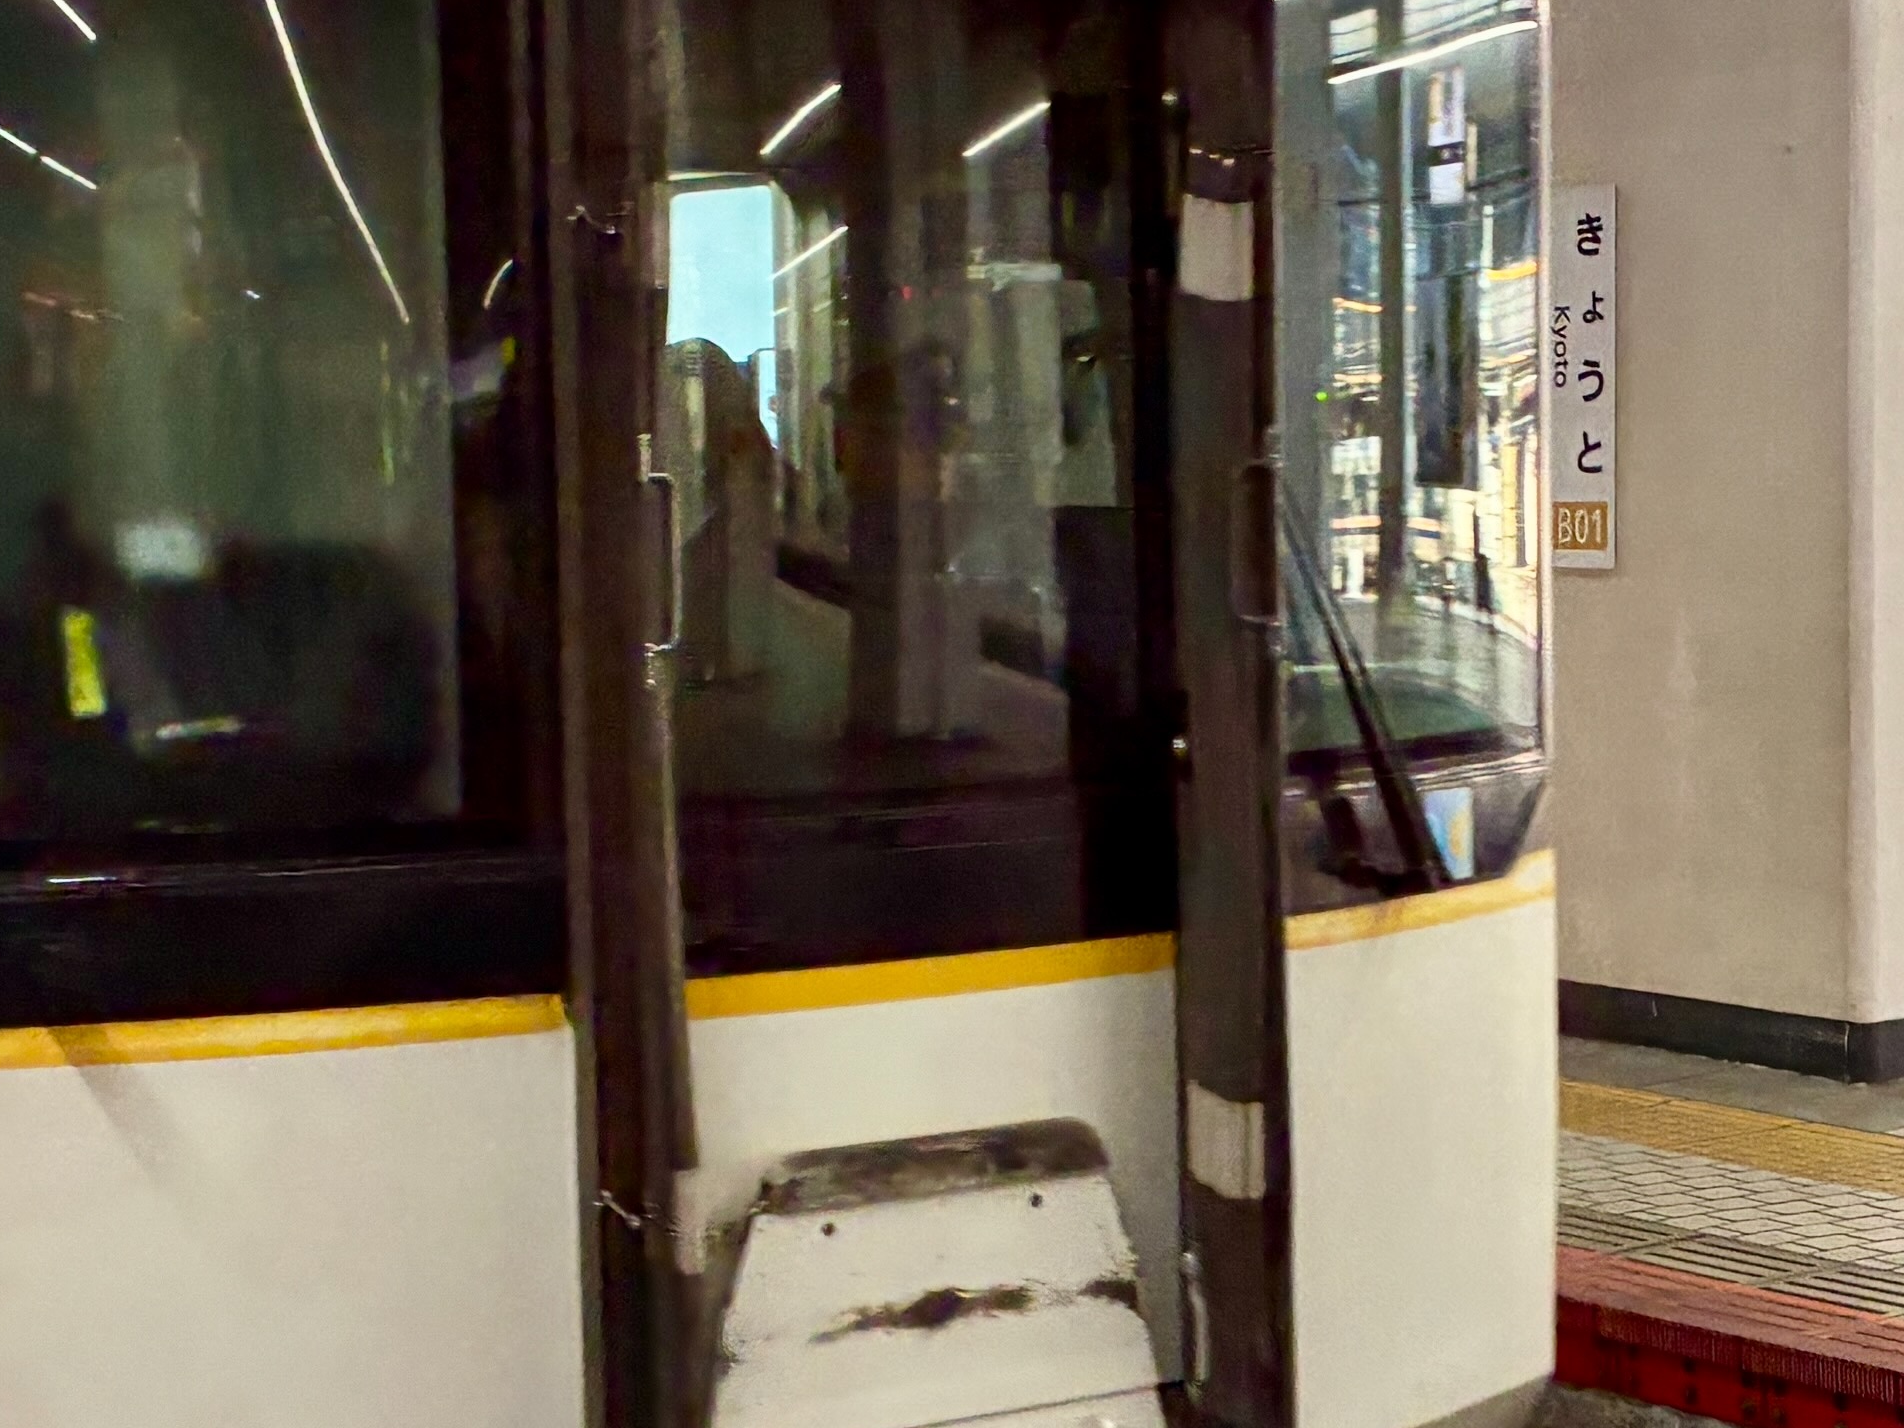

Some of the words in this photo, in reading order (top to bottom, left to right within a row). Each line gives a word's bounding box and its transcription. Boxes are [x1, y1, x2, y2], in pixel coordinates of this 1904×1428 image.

[1551, 306, 1571, 388] Kyoto
[1576, 212, 1604, 474] きょうと
[1558, 507, 1601, 544] B01
